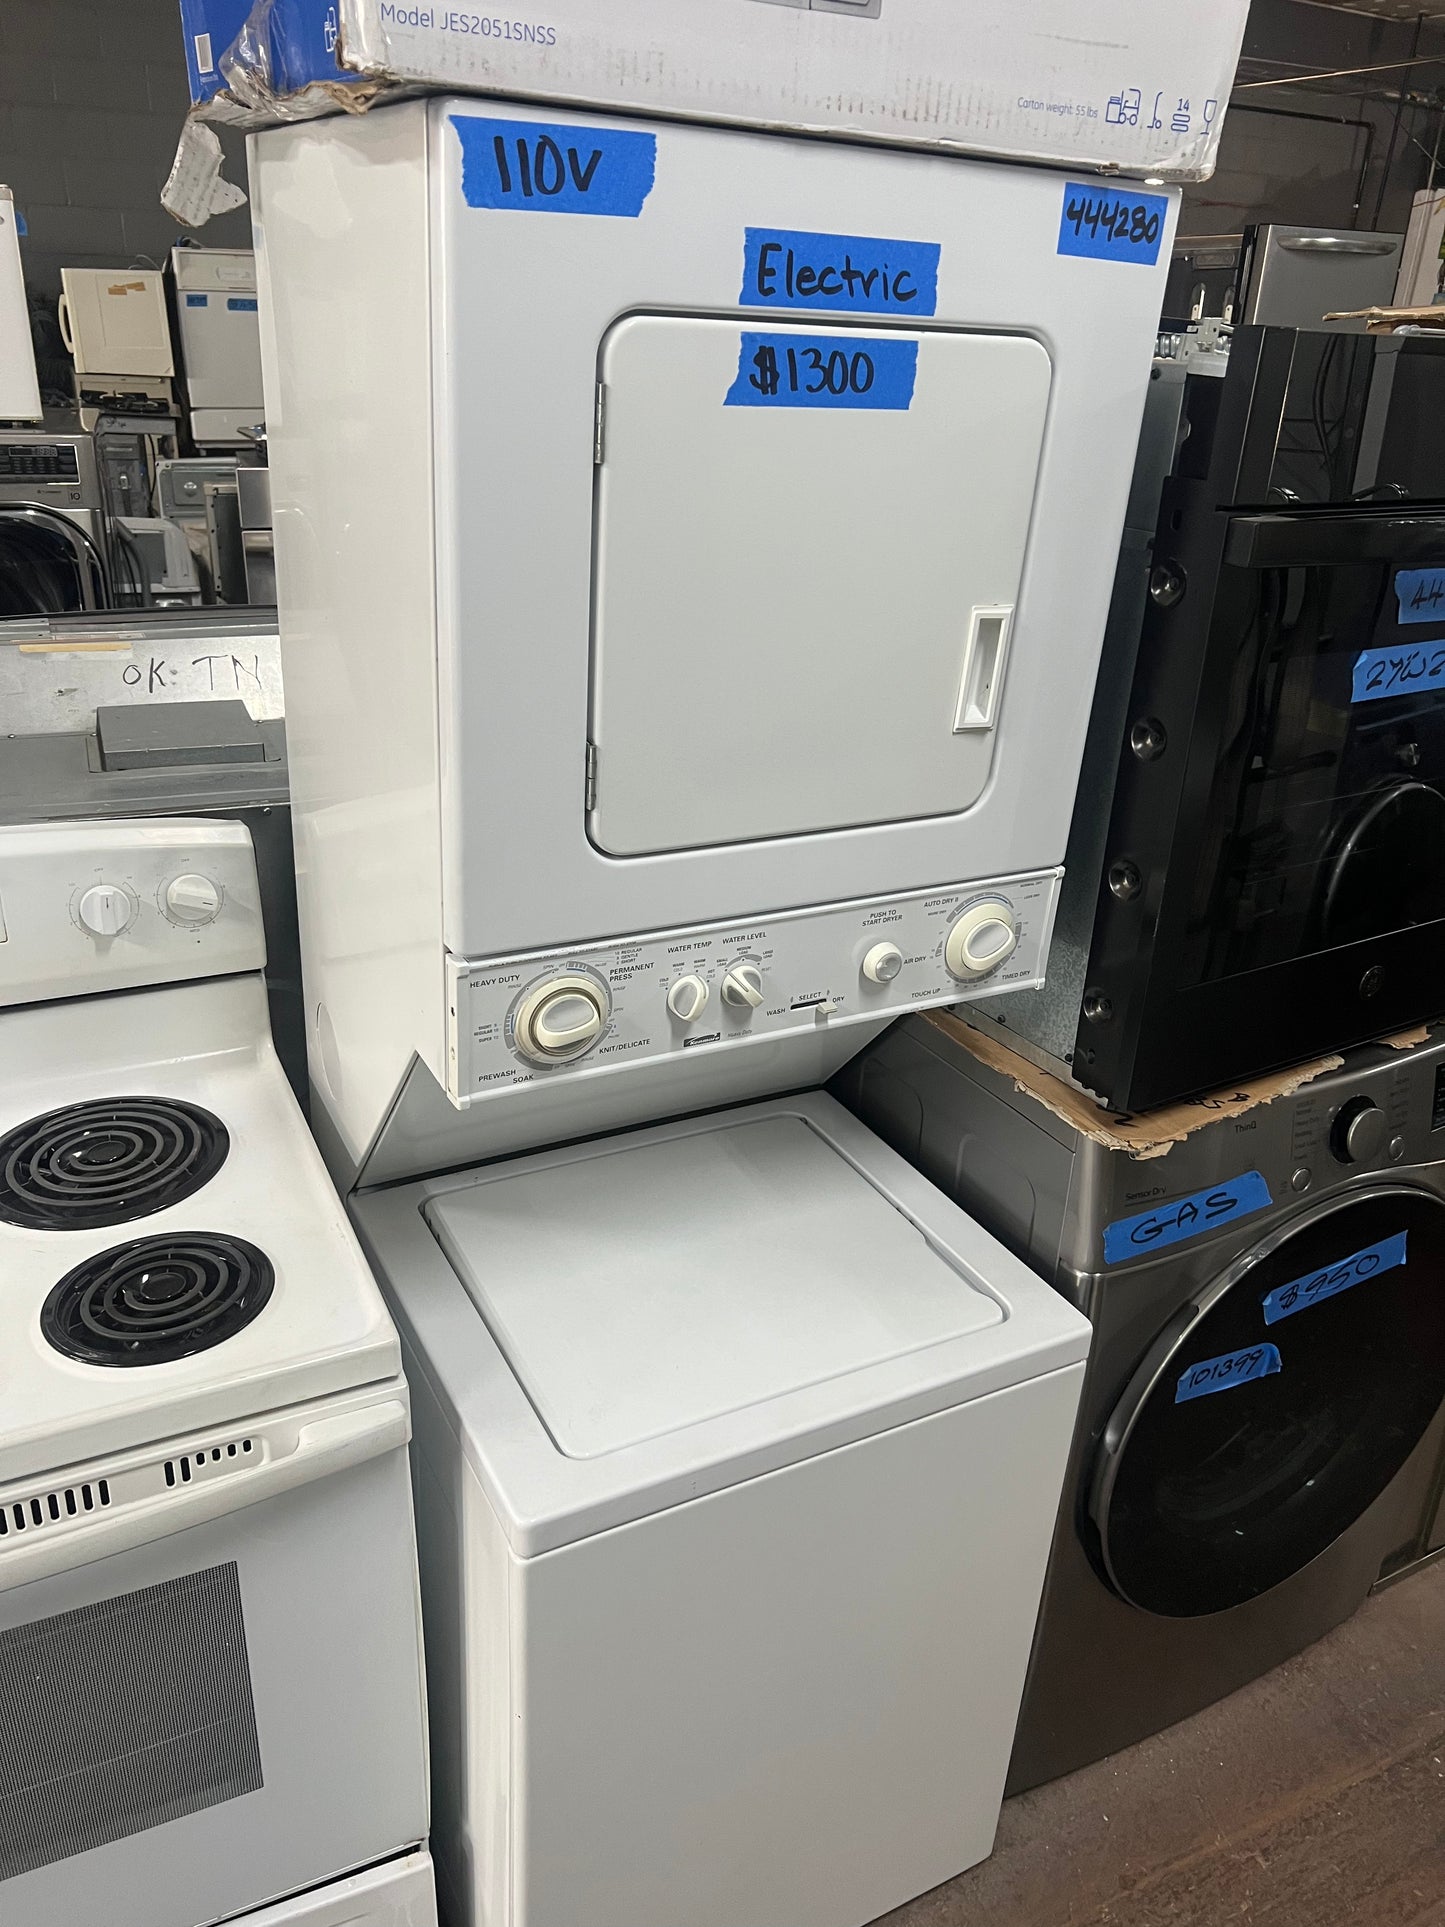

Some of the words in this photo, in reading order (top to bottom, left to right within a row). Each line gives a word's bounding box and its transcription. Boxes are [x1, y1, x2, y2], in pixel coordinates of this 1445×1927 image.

[380, 2, 435, 28] Model
[439, 11, 557, 46] JES2051SNSS
[1017, 97, 1044, 110] Carton
[1087, 106, 1099, 118] lbs
[1177, 98, 1190, 112] 14
[1066, 197, 1158, 243] 444280
[757, 243, 918, 302] Electric
[748, 346, 875, 396] $1300
[924, 899, 940, 907] AUTO
[862, 917, 882, 927] START
[883, 914, 902, 923] DRYER
[870, 910, 884, 919] PUSH
[886, 909, 897, 917] TO
[723, 935, 745, 944] WATER
[747, 932, 767, 941] LEVEL
[668, 943, 692, 954] WATER
[693, 941, 712, 950] TEMP
[609, 962, 655, 975] PERMANENT
[1019, 970, 1031, 978] DRY
[470, 978, 497, 989] HEAVY
[498, 974, 521, 984] DUTY
[609, 974, 633, 983] PRESS
[798, 991, 821, 1001] SELECT
[911, 990, 932, 998] TOUCH
[766, 1007, 786, 1017] WASH
[599, 1038, 651, 1054] KNIT/DELICATE
[478, 1069, 517, 1083] PREWASH
[512, 1074, 534, 1084] SOAK
[1234, 1121, 1257, 1134] ThinQ
[1125, 1190, 1151, 1202] Sensor
[1152, 1186, 1167, 1198] Dry
[1130, 1192, 1238, 1244] GAS
[1278, 1254, 1380, 1310] $950
